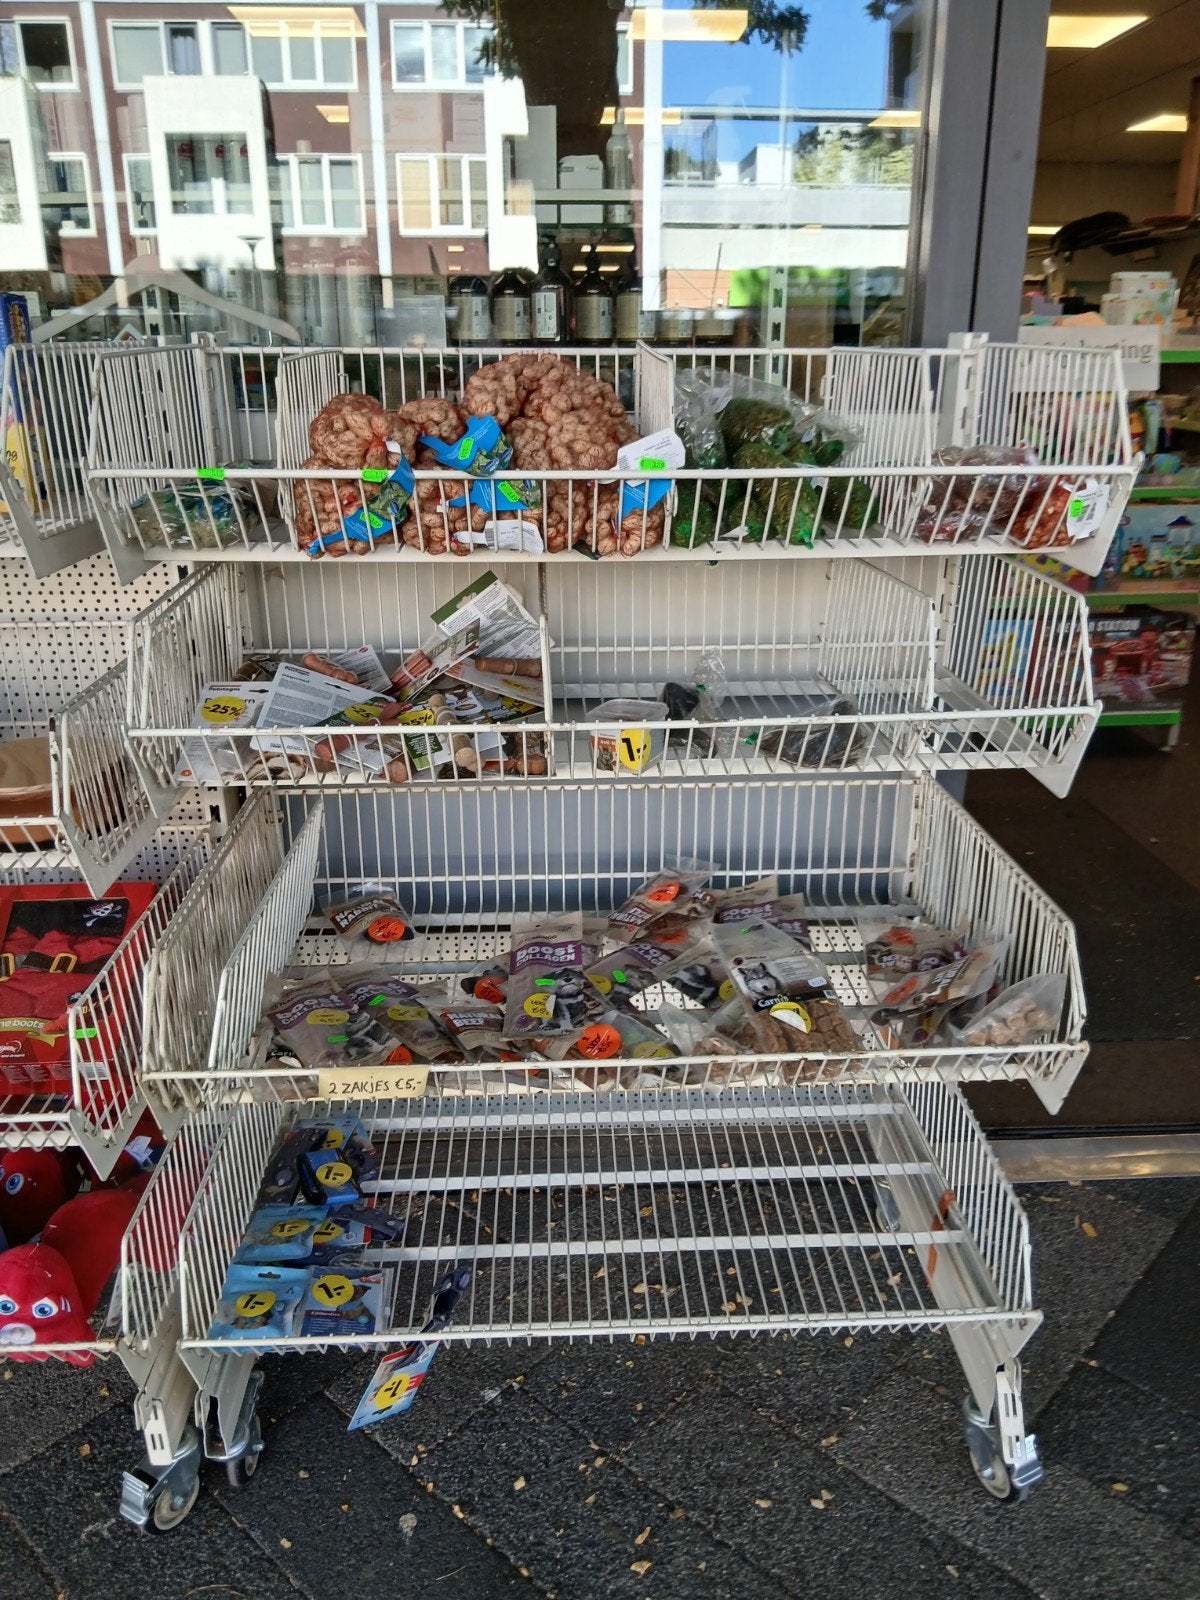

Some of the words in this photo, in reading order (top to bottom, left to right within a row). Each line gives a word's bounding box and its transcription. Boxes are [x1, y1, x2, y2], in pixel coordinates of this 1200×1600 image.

[203, 703, 244, 717] -25%
[516, 952, 576, 968] COLLAGEN
[12, 1019, 45, 1029] boots
[328, 1082, 338, 1094] 2
[394, 1078, 422, 1091] €5,-
